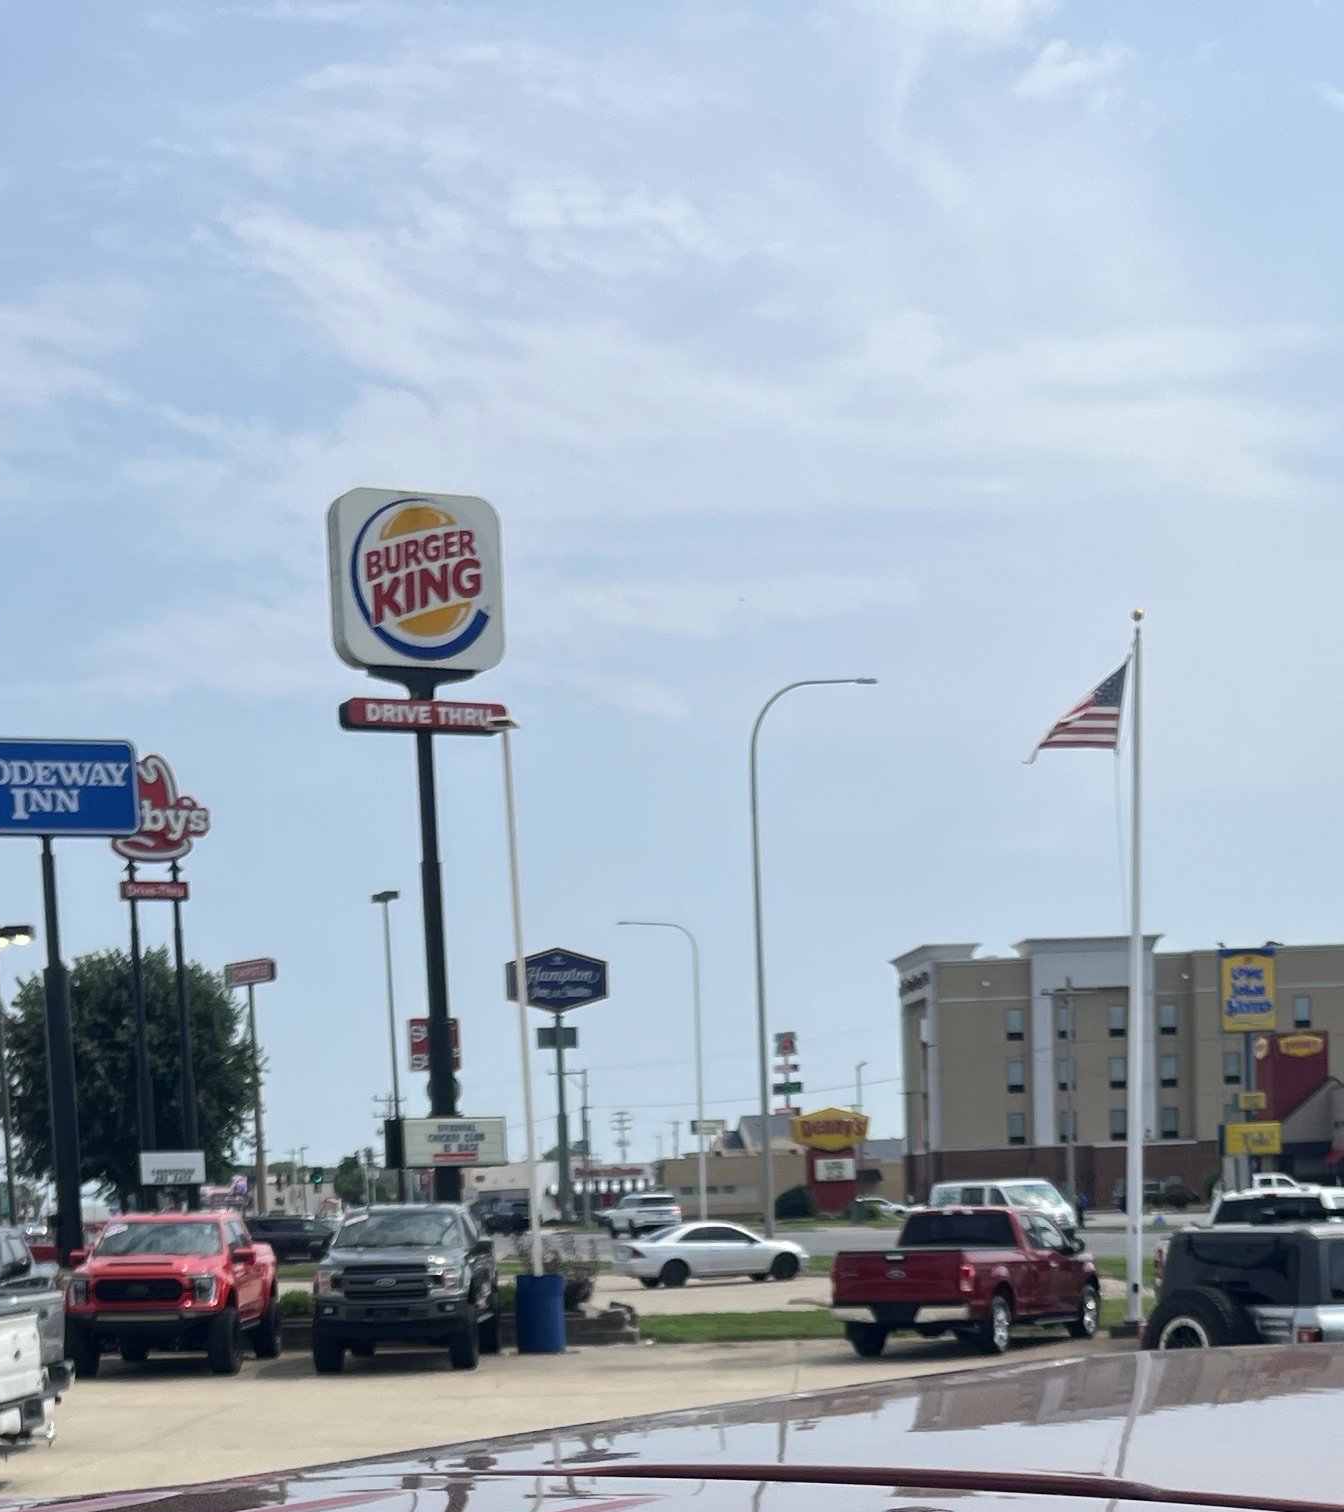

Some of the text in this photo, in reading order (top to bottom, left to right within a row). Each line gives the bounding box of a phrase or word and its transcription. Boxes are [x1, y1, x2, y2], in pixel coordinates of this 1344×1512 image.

[364, 529, 477, 582] BURGER
[370, 558, 483, 626] KING
[365, 703, 493, 728] DRIVE THRU
[11, 788, 80, 820] INN
[140, 800, 209, 840] by's
[526, 966, 601, 986] Hampton
[800, 1118, 867, 1140] Denny's
